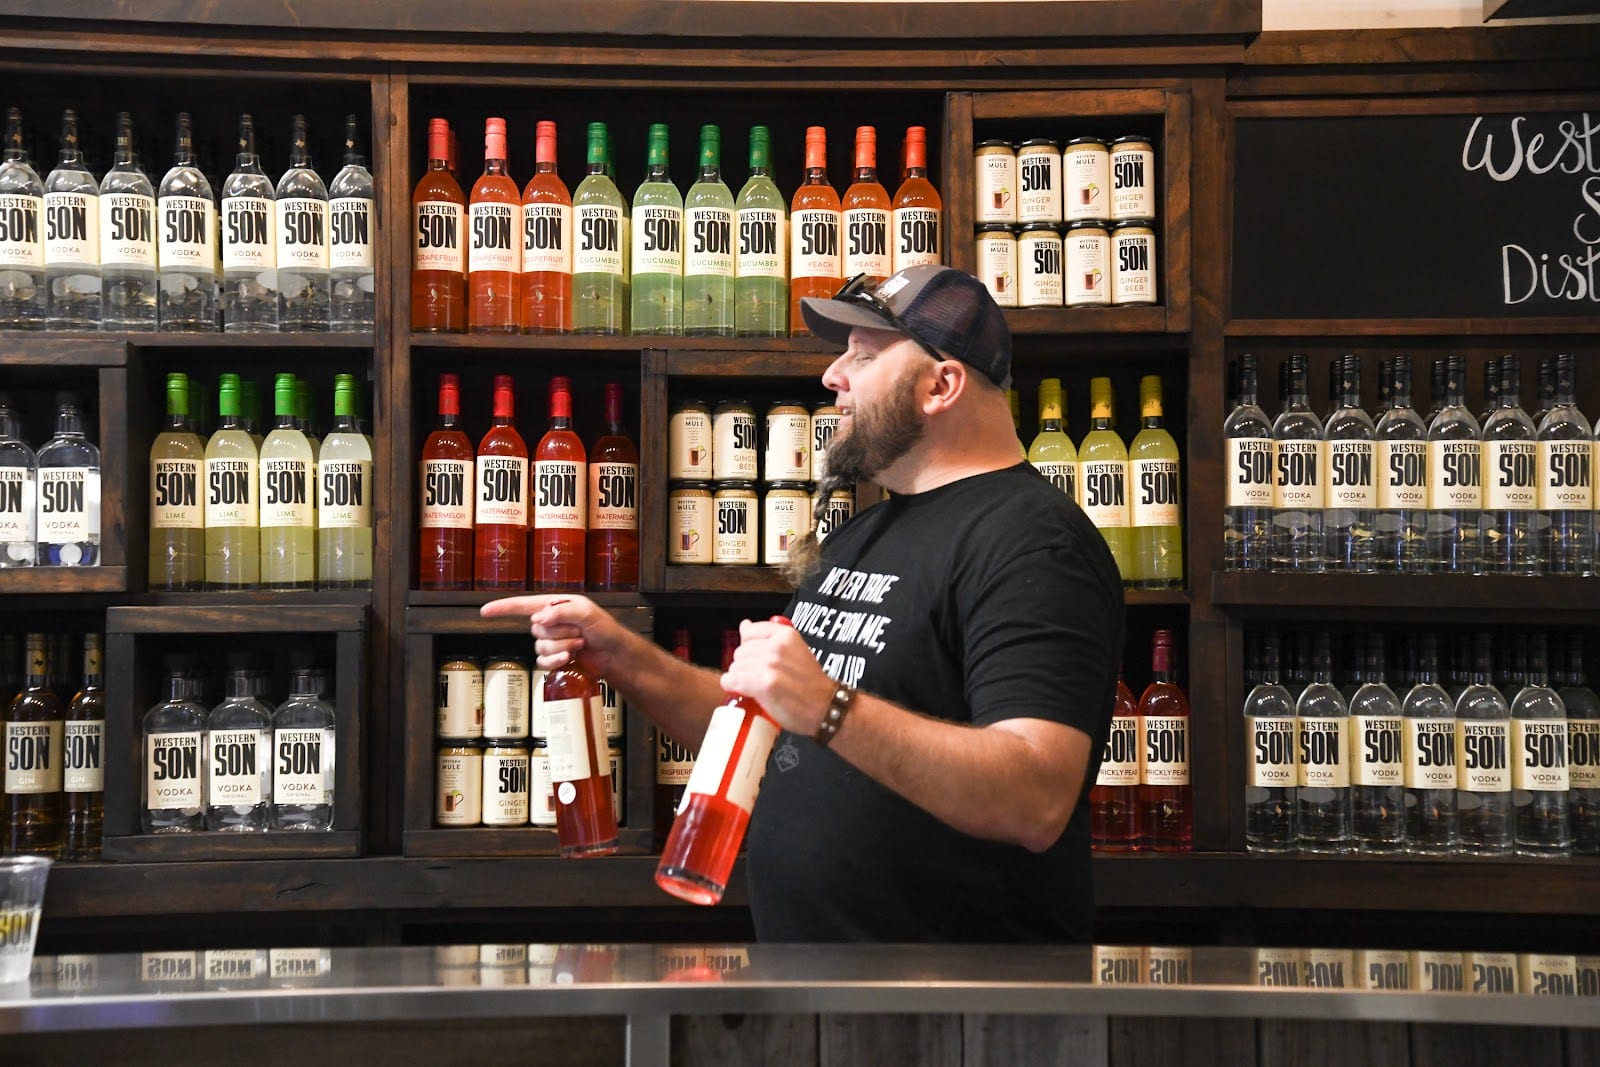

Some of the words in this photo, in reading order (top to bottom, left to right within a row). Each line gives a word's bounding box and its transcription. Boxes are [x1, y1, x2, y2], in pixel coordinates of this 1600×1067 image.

[1463, 113, 1600, 181] West
[1022, 157, 1050, 165] WESTERN
[1114, 155, 1143, 164] WESTERN
[1022, 166, 1050, 191] SON
[1114, 164, 1143, 188] SON
[47, 197, 85, 207] WESTERN
[111, 198, 150, 208] WESTERN
[166, 201, 205, 211] WESTERN
[228, 202, 266, 211] WESTERN
[284, 202, 322, 212] WESTERN
[331, 202, 367, 211] WESTERN
[419, 206, 457, 216] WESTERN
[474, 208, 511, 216] WESTERN
[524, 208, 562, 216] WESTERN
[582, 209, 618, 218] WESTERN
[0, 208, 38, 243] SON
[48, 208, 86, 240] SON
[112, 209, 150, 242] SON
[644, 210, 680, 219] WESTERN
[694, 211, 730, 221] WESTERN
[740, 212, 776, 221] WESTERN
[802, 213, 838, 222] WESTERN
[849, 213, 885, 222] WESTERN
[901, 211, 937, 220] WESTERN
[166, 210, 205, 244] SON
[228, 212, 267, 244] SON
[285, 212, 323, 245] SON
[332, 211, 368, 244] SON
[419, 216, 456, 248] SON
[474, 217, 511, 249] SON
[525, 217, 562, 250] SON
[582, 218, 618, 251] SON
[644, 219, 680, 252] SON
[694, 220, 730, 253] SON
[740, 221, 776, 254] SON
[802, 222, 838, 256] SON
[849, 222, 885, 255] SON
[901, 220, 937, 254] SON
[1119, 238, 1147, 246] WESTERN
[1034, 250, 1059, 274] SON
[1119, 246, 1148, 271] SON
[1503, 244, 1600, 304] Dist
[734, 425, 757, 449] SON
[1278, 444, 1317, 452] WESTERN
[1333, 443, 1372, 453] WESTERN
[1391, 444, 1426, 453] WESTERN
[1444, 443, 1480, 453] WESTERN
[1500, 444, 1535, 453] WESTERN
[1550, 443, 1589, 453] WESTERN
[157, 463, 196, 472] WESTERN
[209, 462, 248, 471] WESTERN
[267, 461, 305, 471] WESTERN
[324, 463, 362, 472] WESTERN
[426, 464, 464, 473] WESTERN
[484, 459, 521, 468] WESTERN
[539, 465, 576, 473] WESTERN
[599, 466, 635, 475] WESTERN
[1040, 466, 1075, 474] WESTERN
[1087, 464, 1123, 473] WESTERN
[1141, 463, 1177, 471] WESTERN
[1239, 452, 1272, 484] SON
[1278, 454, 1317, 486] SON
[1333, 453, 1372, 486] SON
[1391, 454, 1426, 486] SON
[1443, 454, 1480, 486] SON
[1500, 454, 1535, 486] SON
[1550, 454, 1590, 486] SON
[43, 472, 83, 480] WESTERN
[210, 472, 248, 504] SON
[267, 472, 305, 503] SON
[484, 470, 521, 502] SON
[42, 481, 84, 512] SON
[156, 473, 196, 505] SON
[324, 473, 362, 506] SON
[426, 474, 463, 506] SON
[539, 474, 575, 506] SON
[599, 475, 635, 507] SON
[1088, 474, 1124, 506] SON
[1142, 473, 1177, 504] SON
[718, 501, 747, 509] WESTERN
[719, 510, 746, 534] SON
[818, 566, 868, 601] NEVER
[842, 655, 866, 688] UP
[1147, 720, 1184, 729] WESTERN
[1256, 722, 1293, 730] WESTERN
[1300, 722, 1338, 730] WESTERN
[1365, 720, 1400, 729] WESTERN
[1418, 723, 1455, 731] WESTERN
[1465, 725, 1505, 735] WESTERN
[1525, 724, 1564, 733] WESTERN
[154, 737, 196, 746] WESTERN
[214, 734, 256, 743] WESTERN
[280, 733, 321, 742] WESTERN
[1147, 730, 1184, 763] SON
[1256, 732, 1293, 764] SON
[1300, 732, 1338, 764] SON
[1365, 730, 1400, 763] SON
[1418, 733, 1455, 766] SON
[9, 736, 50, 769] SON
[65, 736, 99, 768] SON
[214, 743, 256, 776] SON
[280, 742, 320, 775] SON
[1465, 736, 1506, 768] SON
[1526, 734, 1564, 767] SON
[154, 747, 197, 780] SON
[499, 768, 526, 792] SON
